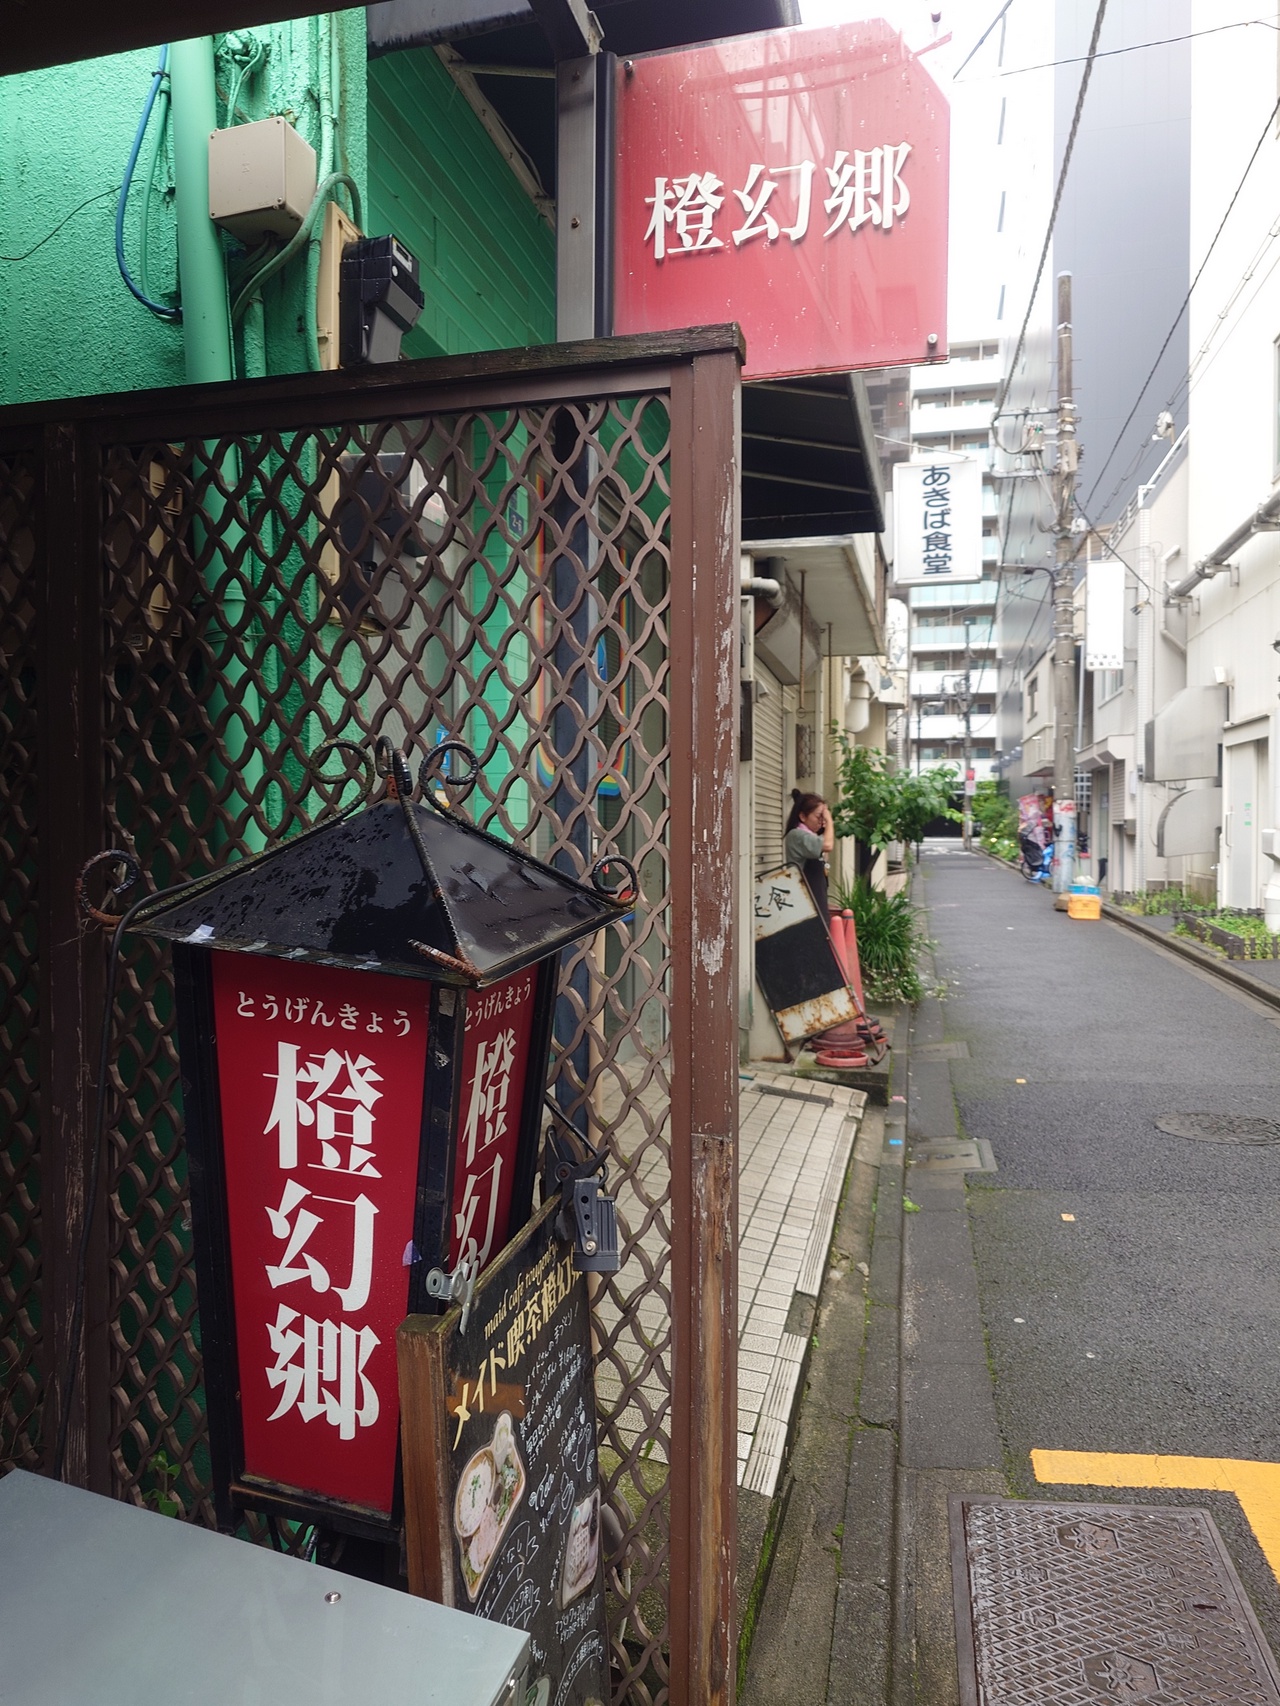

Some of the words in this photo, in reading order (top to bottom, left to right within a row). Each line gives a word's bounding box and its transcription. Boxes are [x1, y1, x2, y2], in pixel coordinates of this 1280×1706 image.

[643, 141, 912, 259] 橙幻郷
[922, 466, 952, 575] あきば食堂
[237, 991, 411, 1036] とうげんきょう
[464, 978, 531, 1031] とうげんきょう
[262, 1041, 384, 1440] 橙幻郷
[484, 1288, 509, 1340] maid
